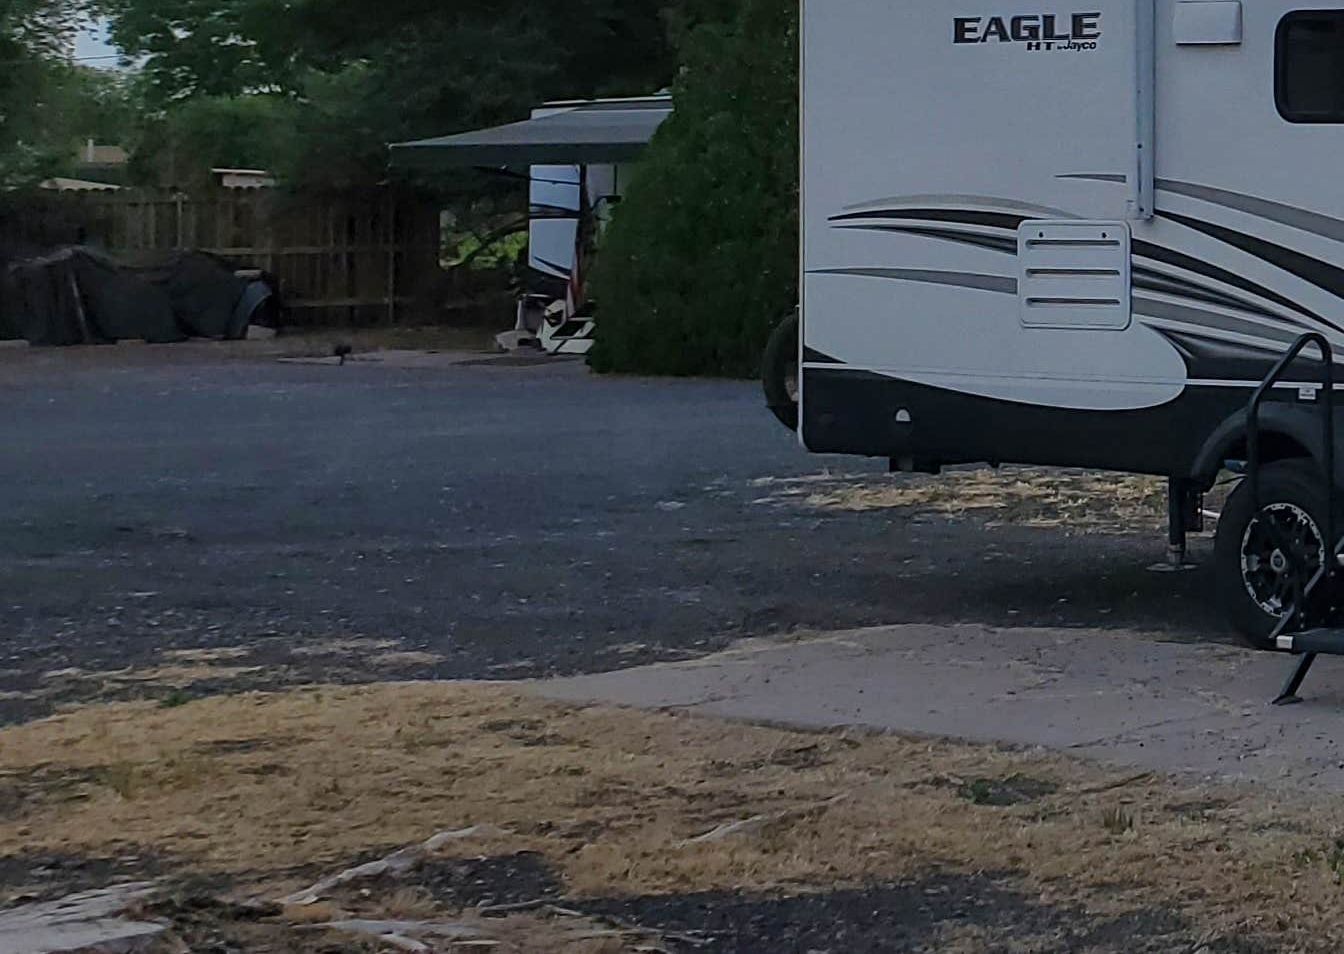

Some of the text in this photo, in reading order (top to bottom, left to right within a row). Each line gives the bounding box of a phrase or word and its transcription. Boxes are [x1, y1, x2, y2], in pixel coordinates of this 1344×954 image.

[953, 12, 1101, 44] EAGLE
[1027, 41, 1055, 51] HT
[1063, 40, 1097, 52] Jayco
